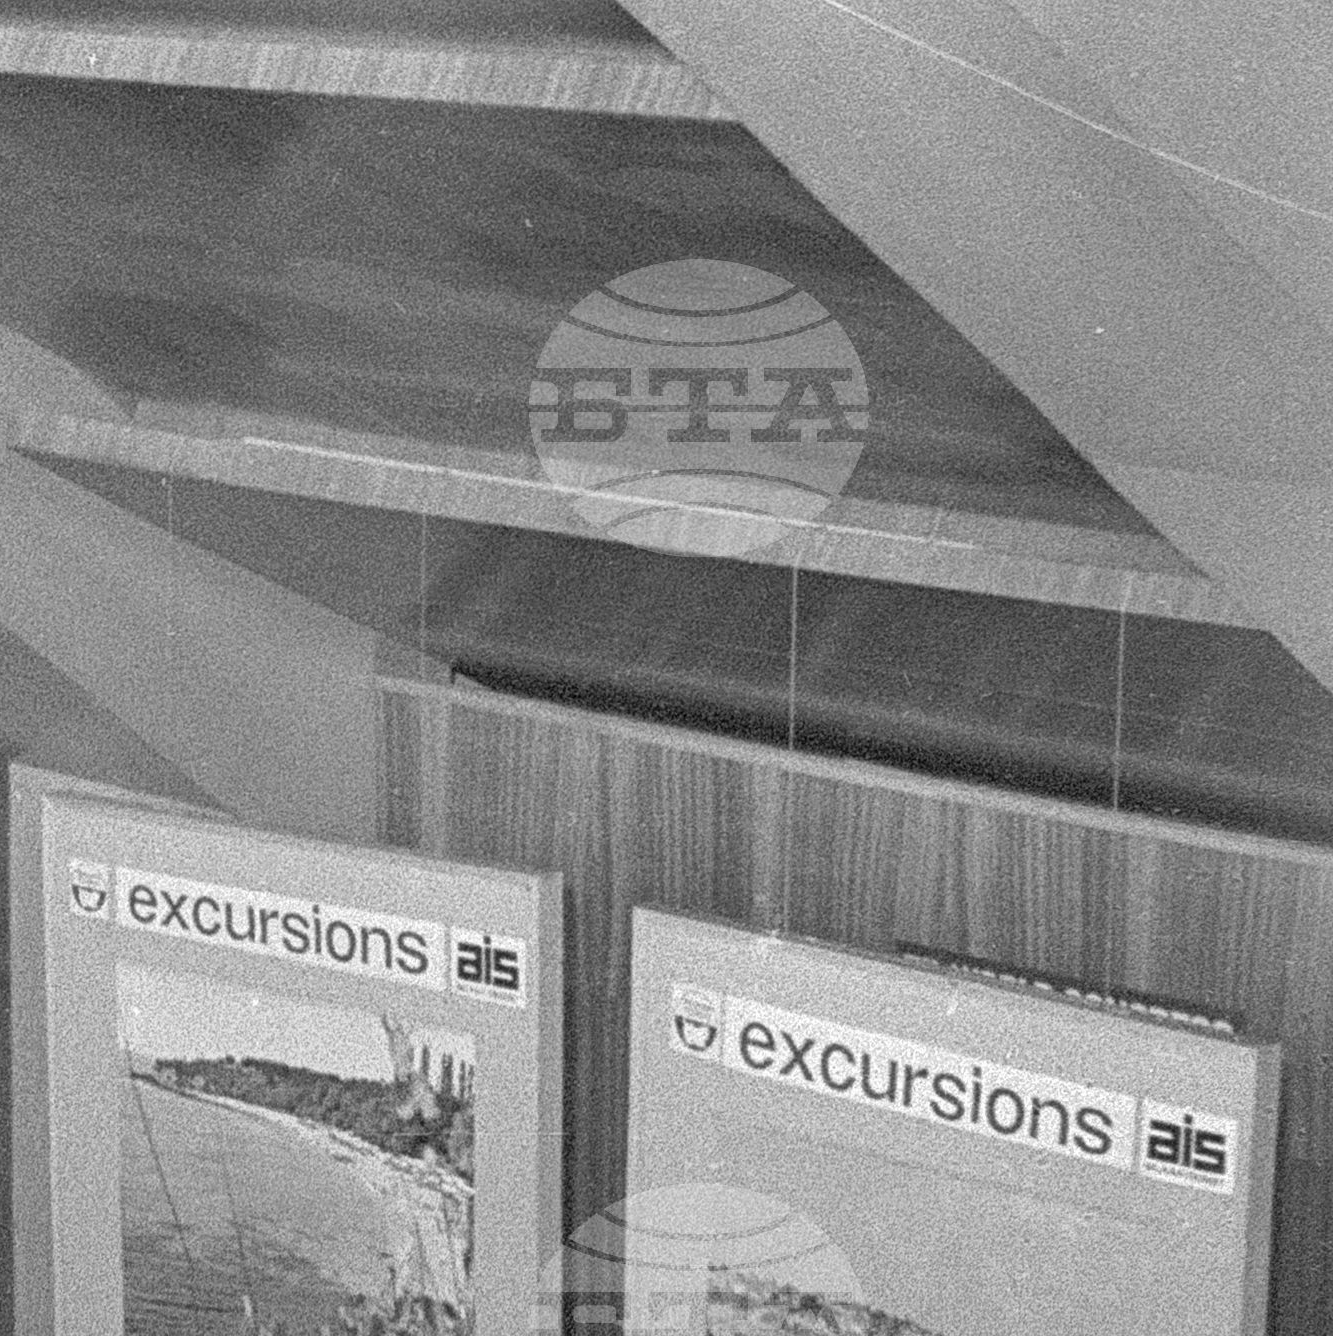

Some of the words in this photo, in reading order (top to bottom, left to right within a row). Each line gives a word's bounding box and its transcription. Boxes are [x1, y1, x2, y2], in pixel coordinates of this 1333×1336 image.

[127, 882, 430, 976] excursions
[457, 935, 520, 991] ais
[737, 1018, 1114, 1157] excursions
[1147, 1113, 1226, 1175] ais
